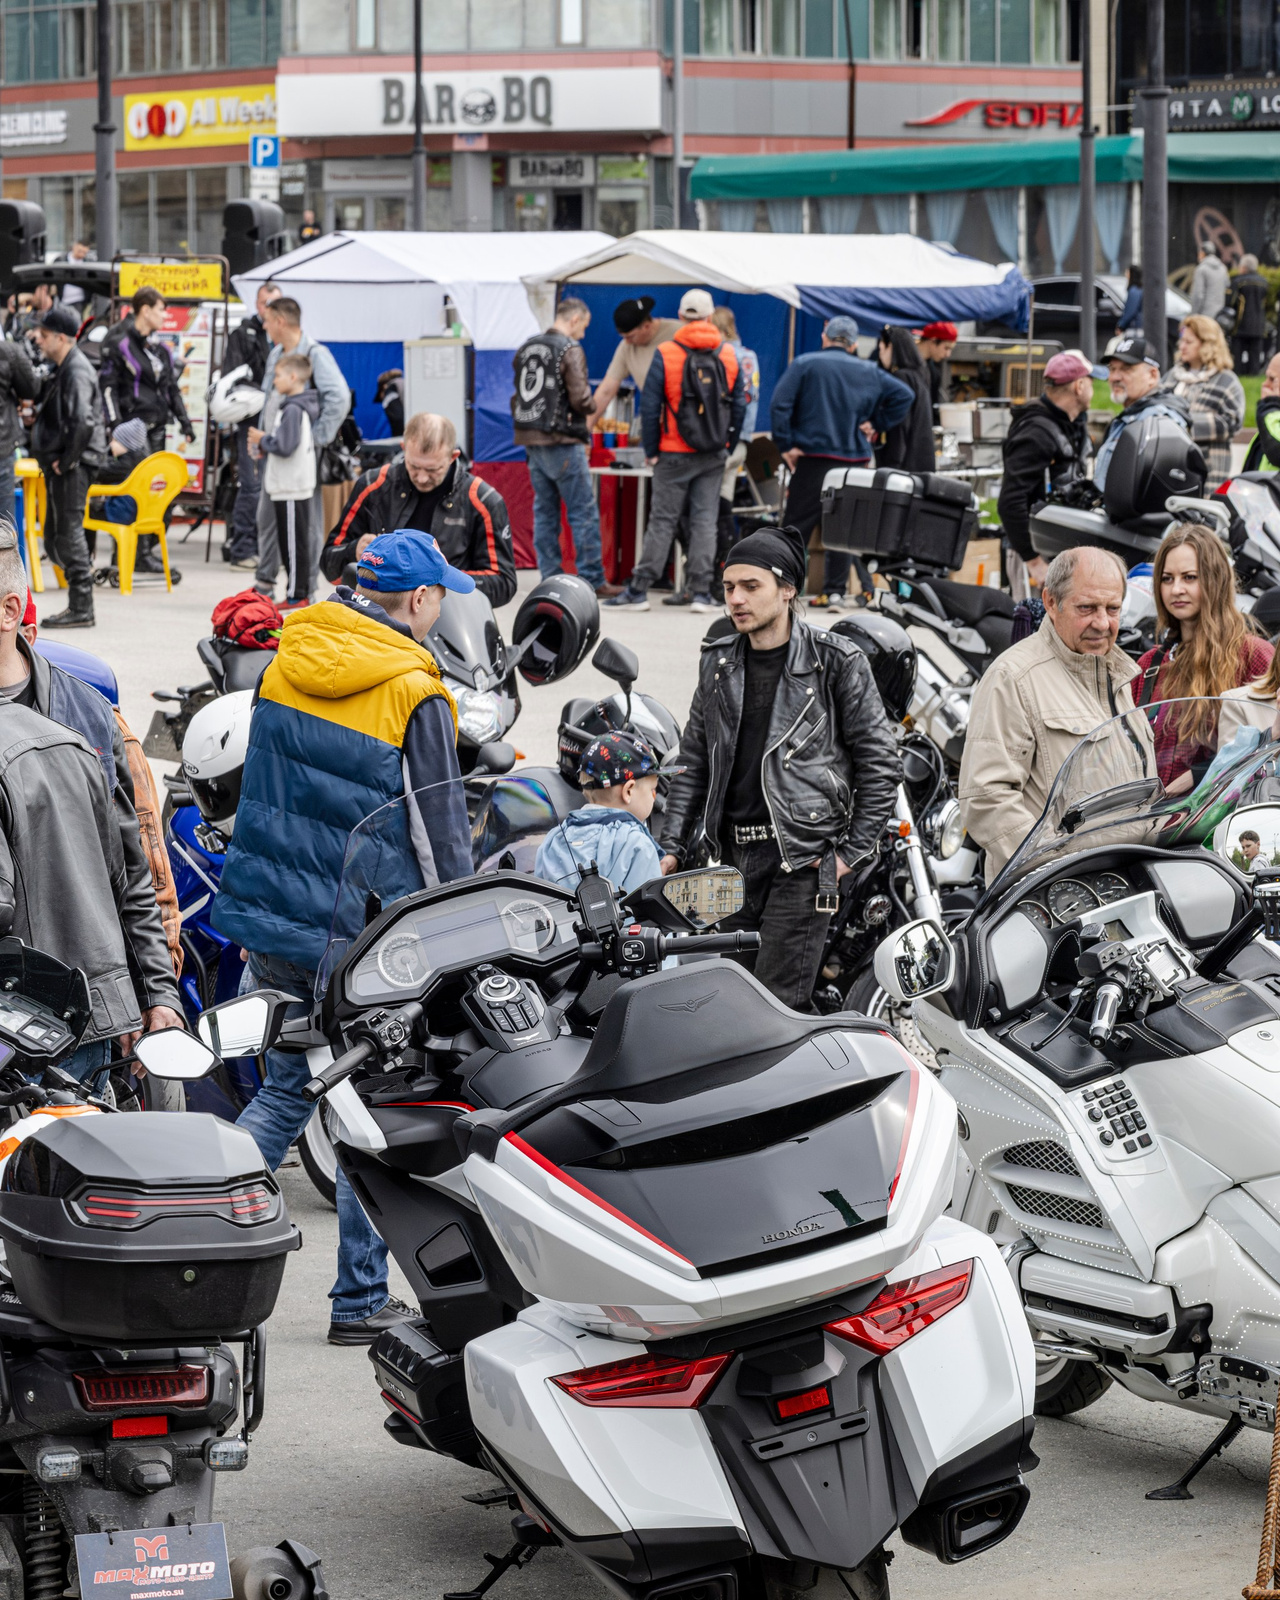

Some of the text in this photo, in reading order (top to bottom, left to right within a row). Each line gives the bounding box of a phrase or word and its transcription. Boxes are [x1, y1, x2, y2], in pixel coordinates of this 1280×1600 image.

[191, 98, 214, 127] All
[382, 76, 553, 126] BAR BQ
[256, 138, 275, 165] P
[525, 1047, 552, 1058] AIRBAG
[761, 1222, 824, 1244] HONDA
[130, 1588, 185, 1600] maxmoto.su
